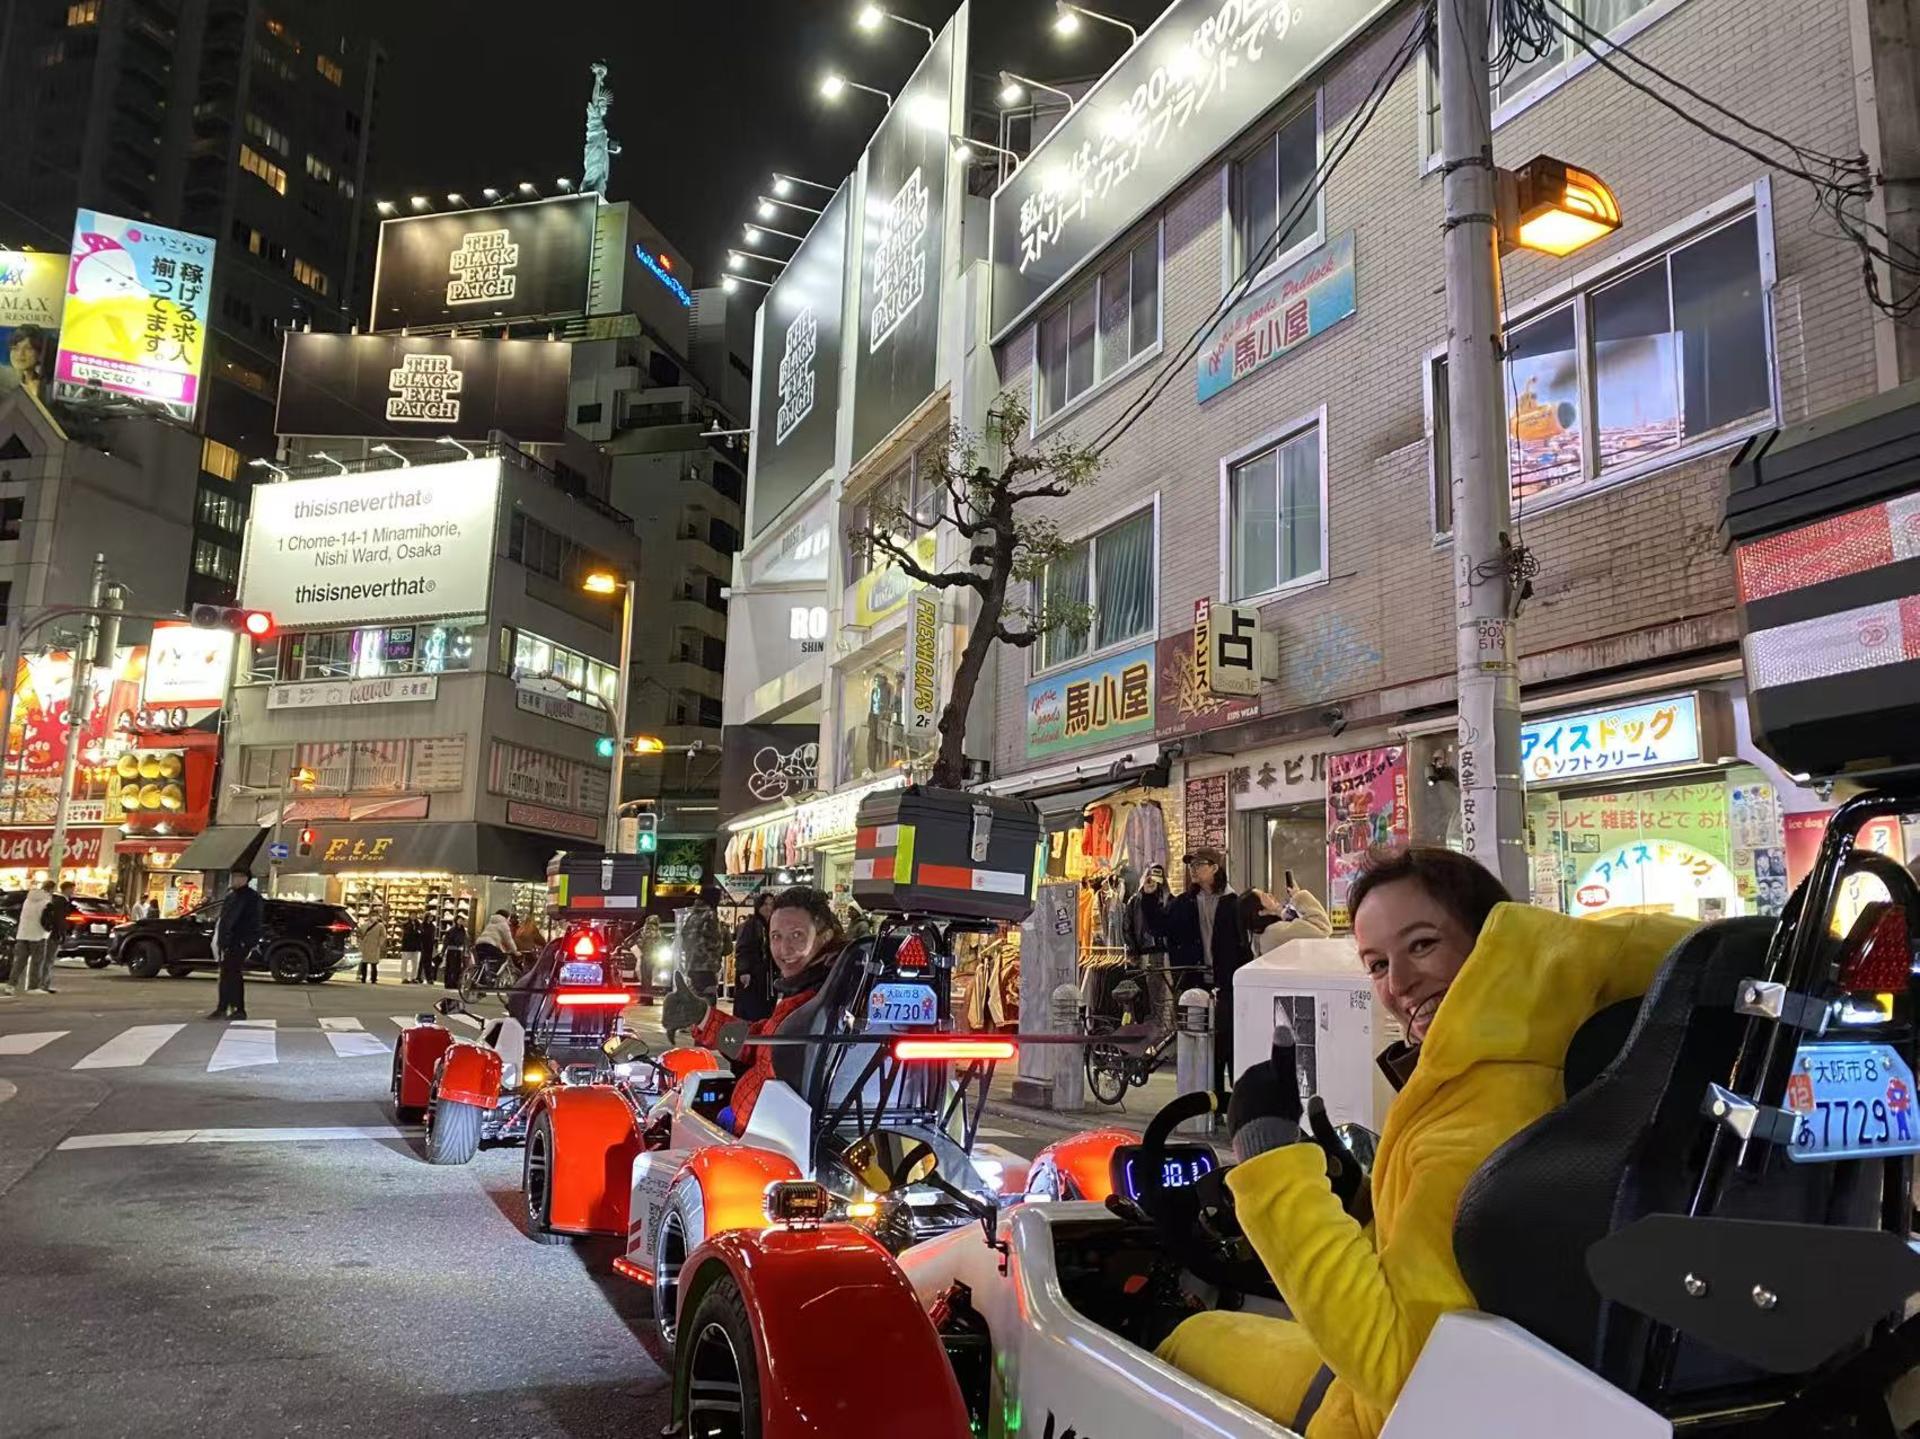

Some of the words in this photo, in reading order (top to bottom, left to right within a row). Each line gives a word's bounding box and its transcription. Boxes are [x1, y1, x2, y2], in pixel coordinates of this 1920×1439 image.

[464, 233, 505, 251] THE
[876, 195, 927, 281] BLACK
[453, 249, 514, 271] BLACK
[465, 266, 499, 283] EYE
[450, 279, 512, 301] PATCH
[1281, 256, 1334, 301] Paddock
[144, 256, 176, 361] 揃ってます。
[170, 261, 203, 365] 稼げる求人
[872, 266, 925, 344] PATCH
[1234, 299, 1309, 377] 馬小屋
[406, 357, 448, 373] THE
[393, 371, 458, 390] BLACK
[405, 387, 443, 402] EYE
[389, 401, 457, 419] PATCH
[779, 389, 814, 434] PATCH
[277, 539, 284, 552] 1
[287, 532, 368, 552] Chome-14-1
[372, 522, 462, 544] Minamihorie,
[314, 550, 347, 566] Nishi
[353, 547, 392, 564] Ward,
[396, 544, 441, 559] Osaka
[916, 598, 936, 663] FRESH
[1219, 610, 1255, 670] 占
[801, 641, 824, 653] SHIN
[914, 662, 936, 714] CAPS
[1065, 663, 1149, 735] 馬小屋
[915, 715, 931, 728] 2F
[1521, 705, 1678, 761] アイスドッグ
[1555, 745, 1659, 774] ソフトクリーム
[1546, 811, 1595, 830] テレビ
[656, 865, 676, 877] 420
[873, 1008, 882, 1019] あ
[885, 1003, 920, 1020] 7730
[1799, 1118, 1816, 1149] あ
[1816, 1099, 1890, 1147] 7729
